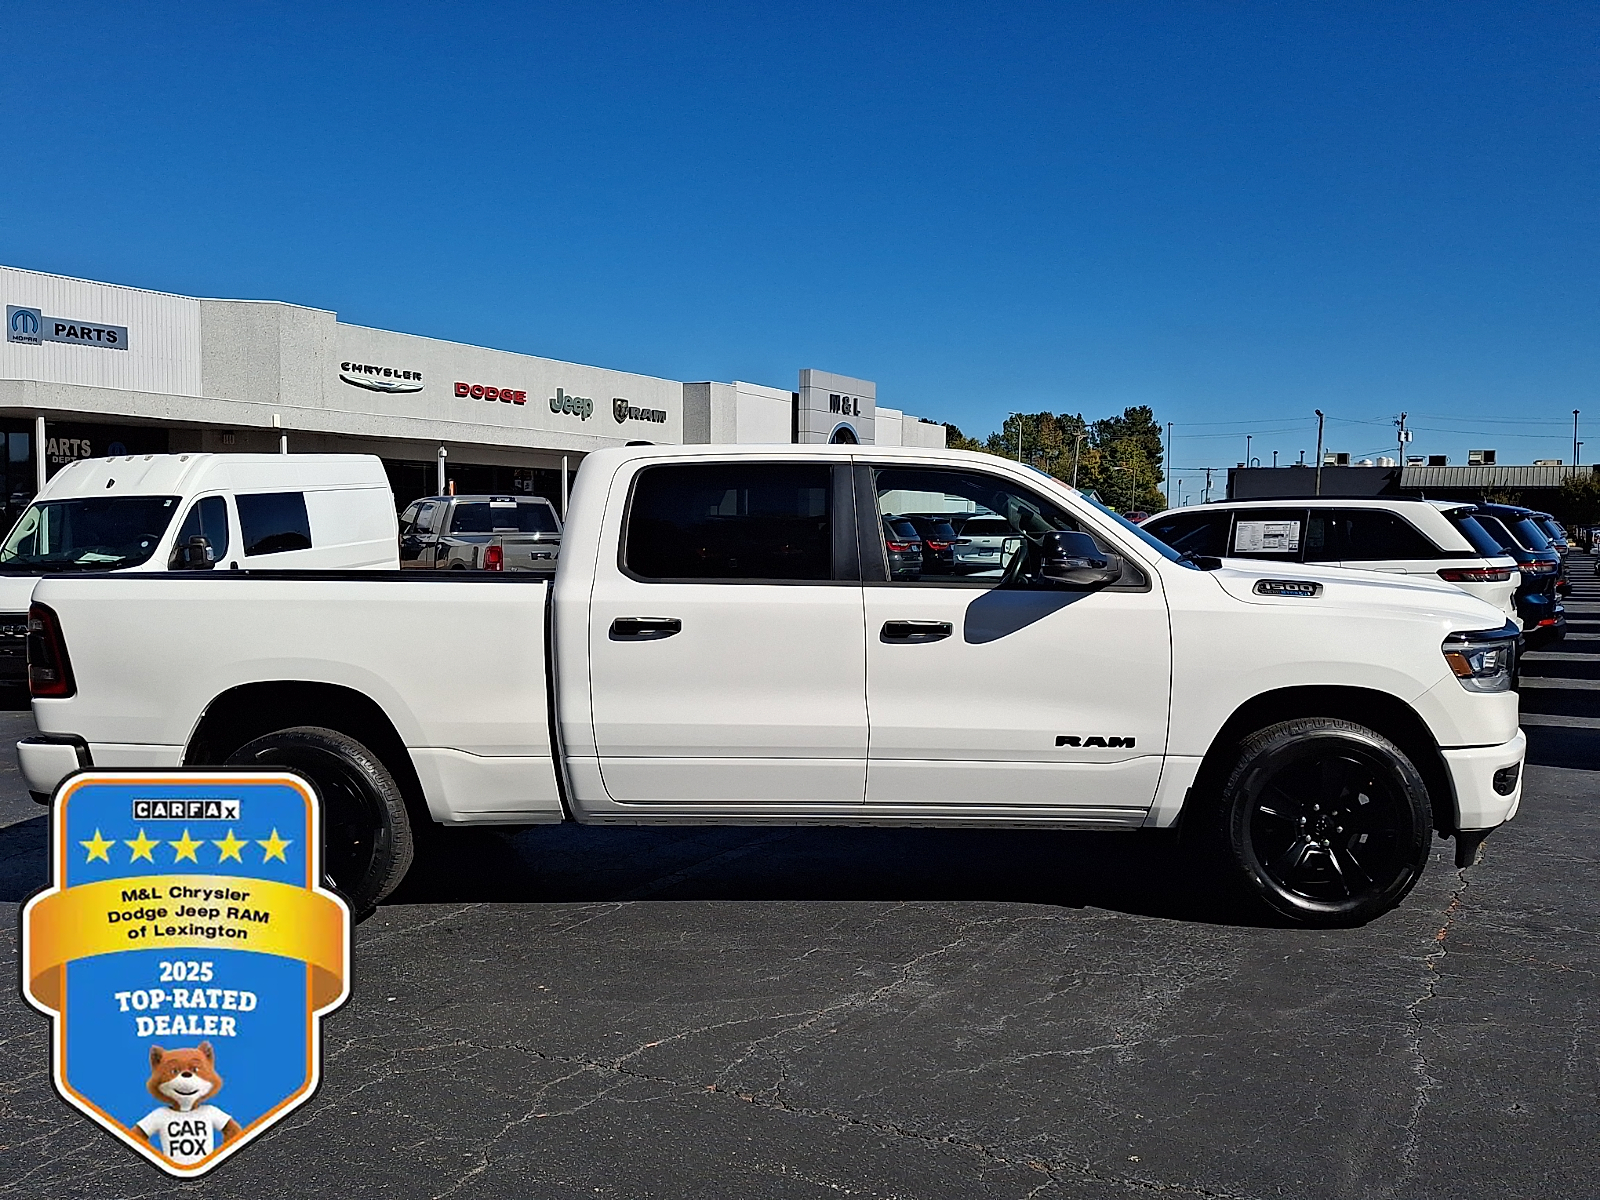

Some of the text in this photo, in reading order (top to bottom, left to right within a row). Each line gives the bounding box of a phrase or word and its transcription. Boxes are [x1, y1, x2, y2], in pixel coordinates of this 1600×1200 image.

[12, 335, 38, 343] MOPAR
[54, 322, 118, 344] PARTS
[340, 362, 423, 381] CHRYSLER
[454, 382, 527, 405] DODGE
[549, 388, 594, 421] Jeep
[829, 393, 862, 417] M&L
[629, 406, 667, 423] RAM
[45, 438, 92, 457] ARTS
[1264, 582, 1314, 592] 1500
[1054, 735, 1136, 748] RAM
